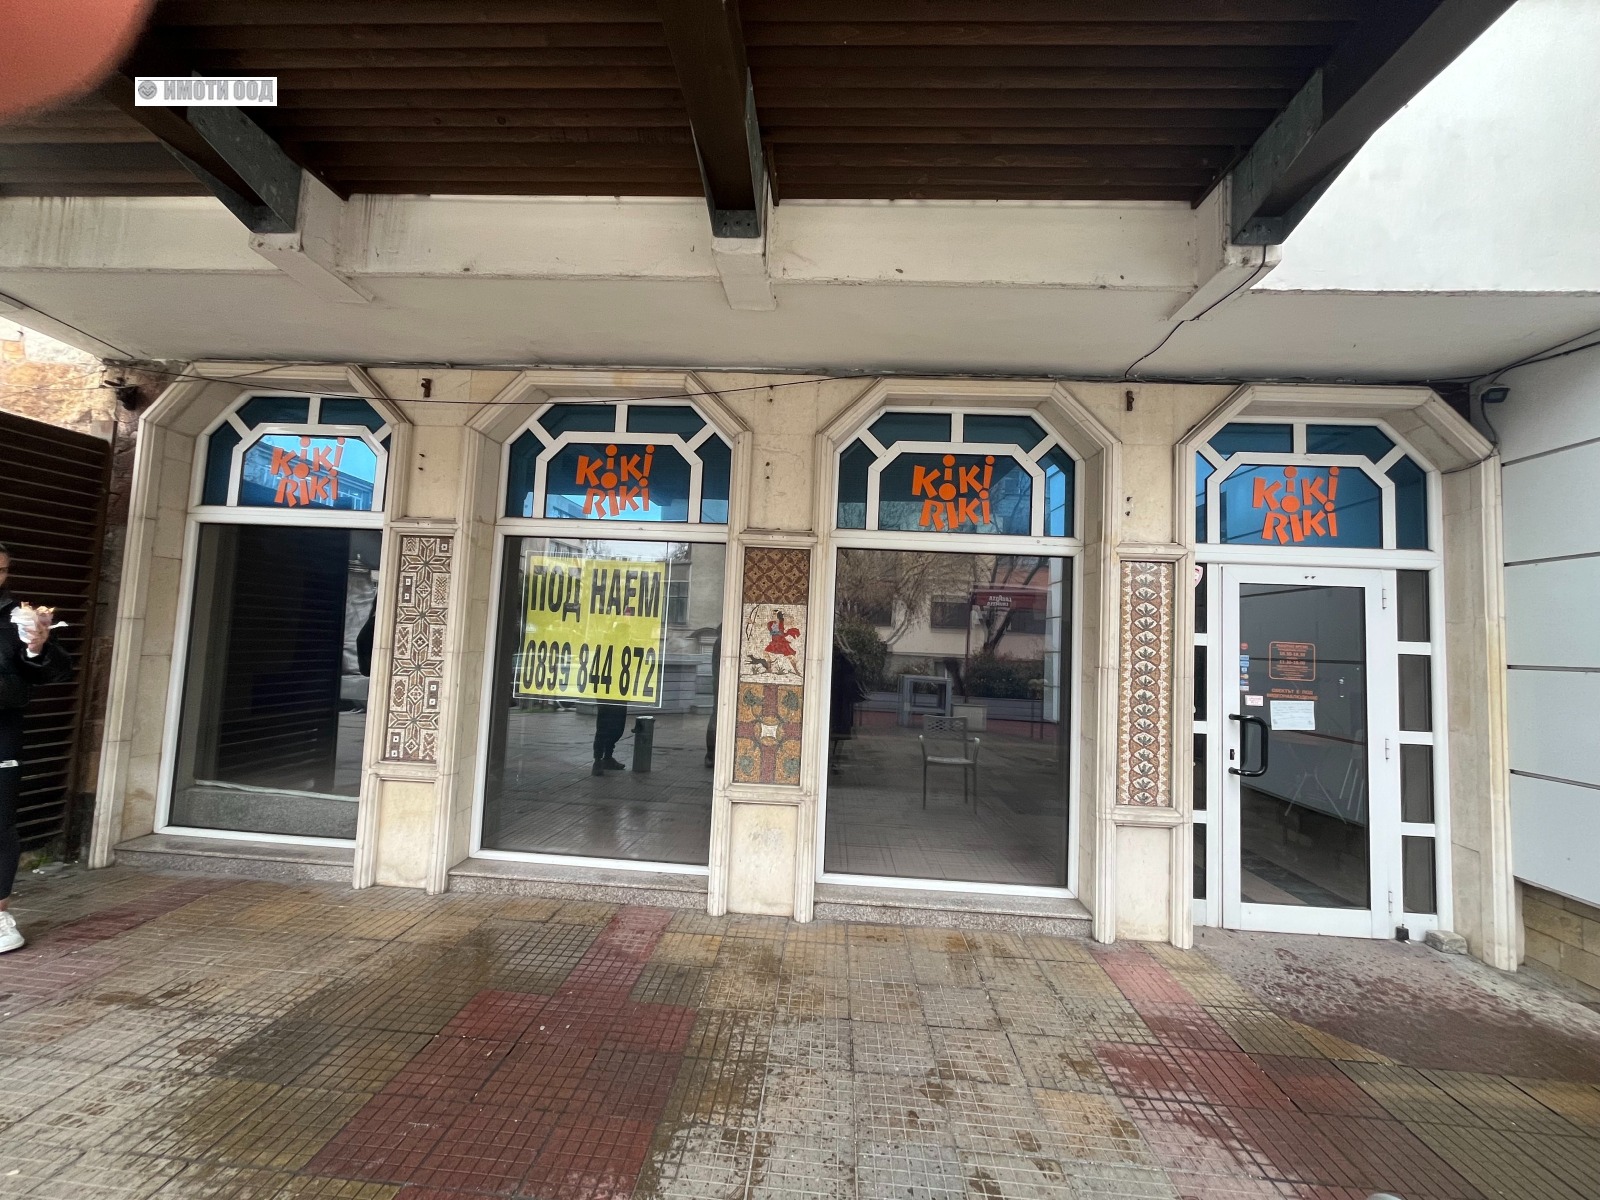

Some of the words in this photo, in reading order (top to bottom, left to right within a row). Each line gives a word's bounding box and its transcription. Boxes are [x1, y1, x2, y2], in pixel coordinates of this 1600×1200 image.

[530, 565, 582, 623] ПОД
[589, 568, 662, 619] НАЕМ
[522, 639, 572, 692] 0899
[576, 643, 614, 695] 844
[618, 645, 657, 698] 872
